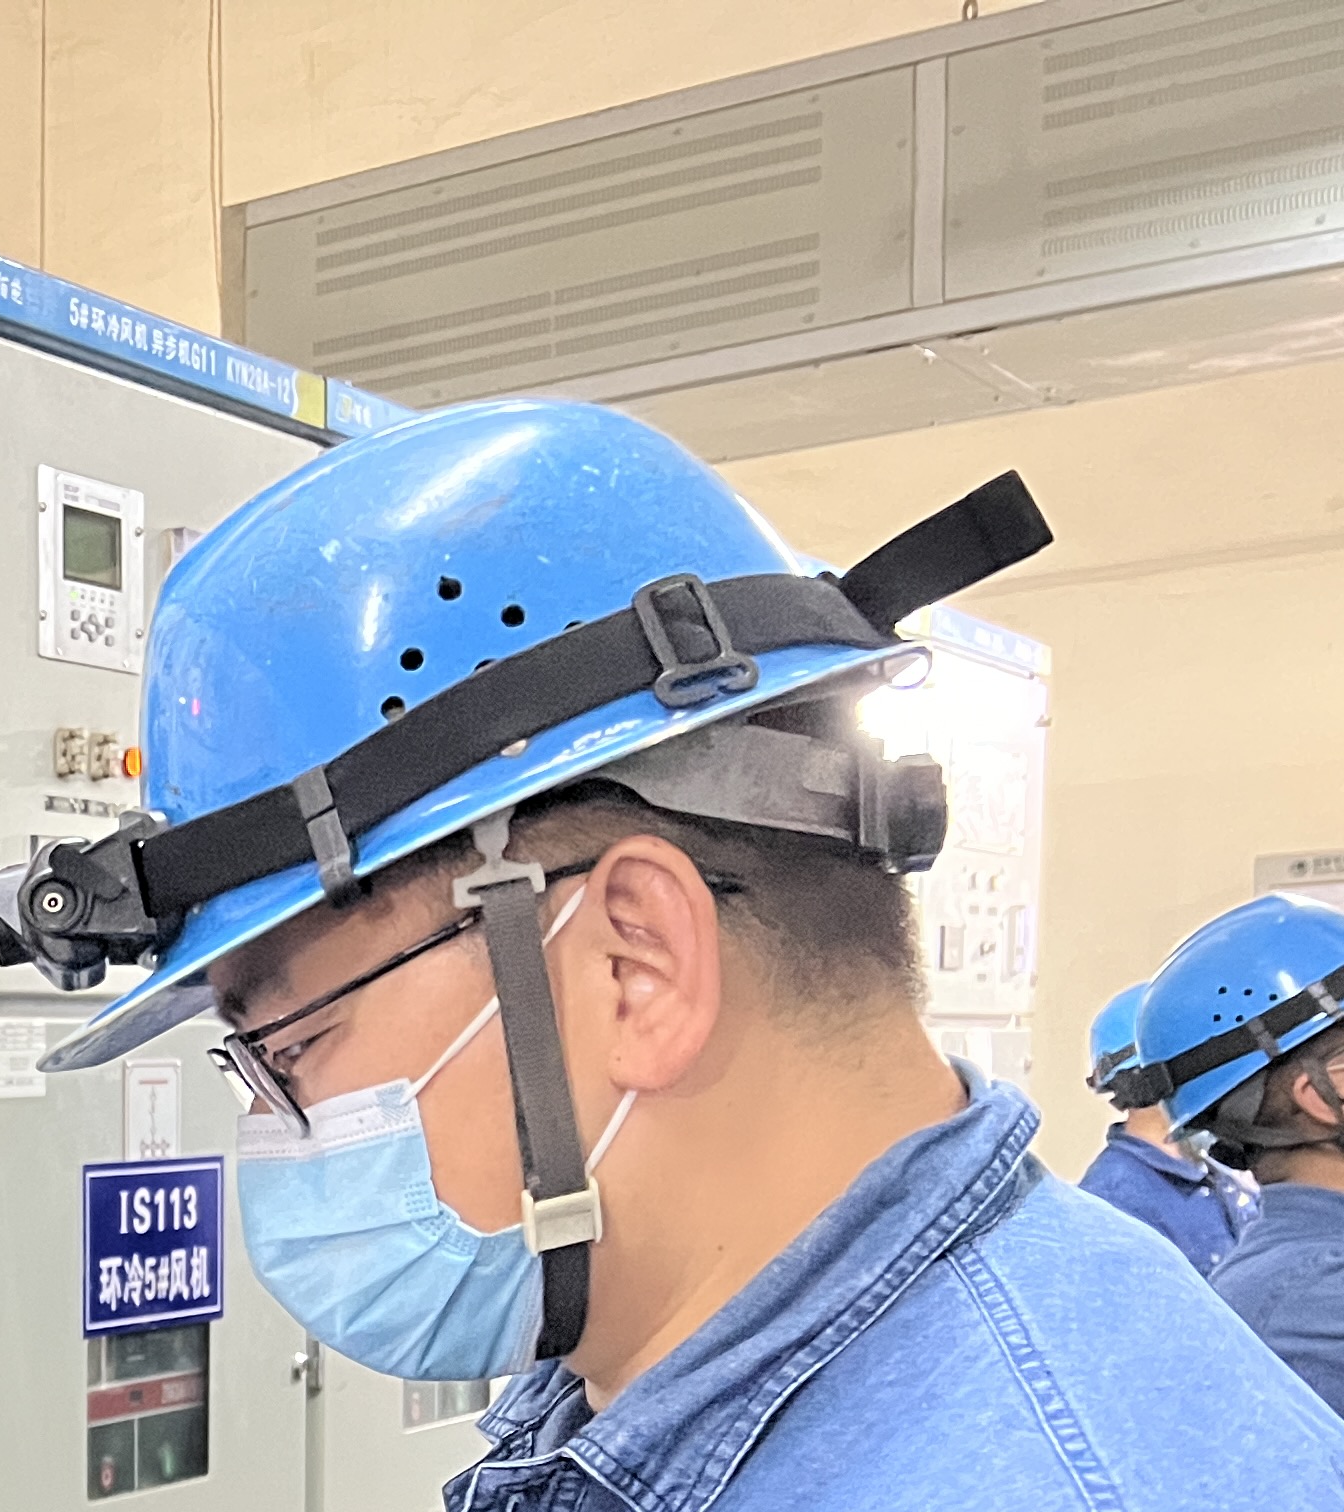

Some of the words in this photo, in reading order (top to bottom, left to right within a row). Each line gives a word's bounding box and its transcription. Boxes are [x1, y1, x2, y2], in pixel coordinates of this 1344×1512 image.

[69, 297, 149, 352] 5#环冷风机
[150, 328, 217, 377] 异步机G11
[119, 1185, 199, 1235] IS113
[99, 1246, 210, 1311] 环冷5#风机
